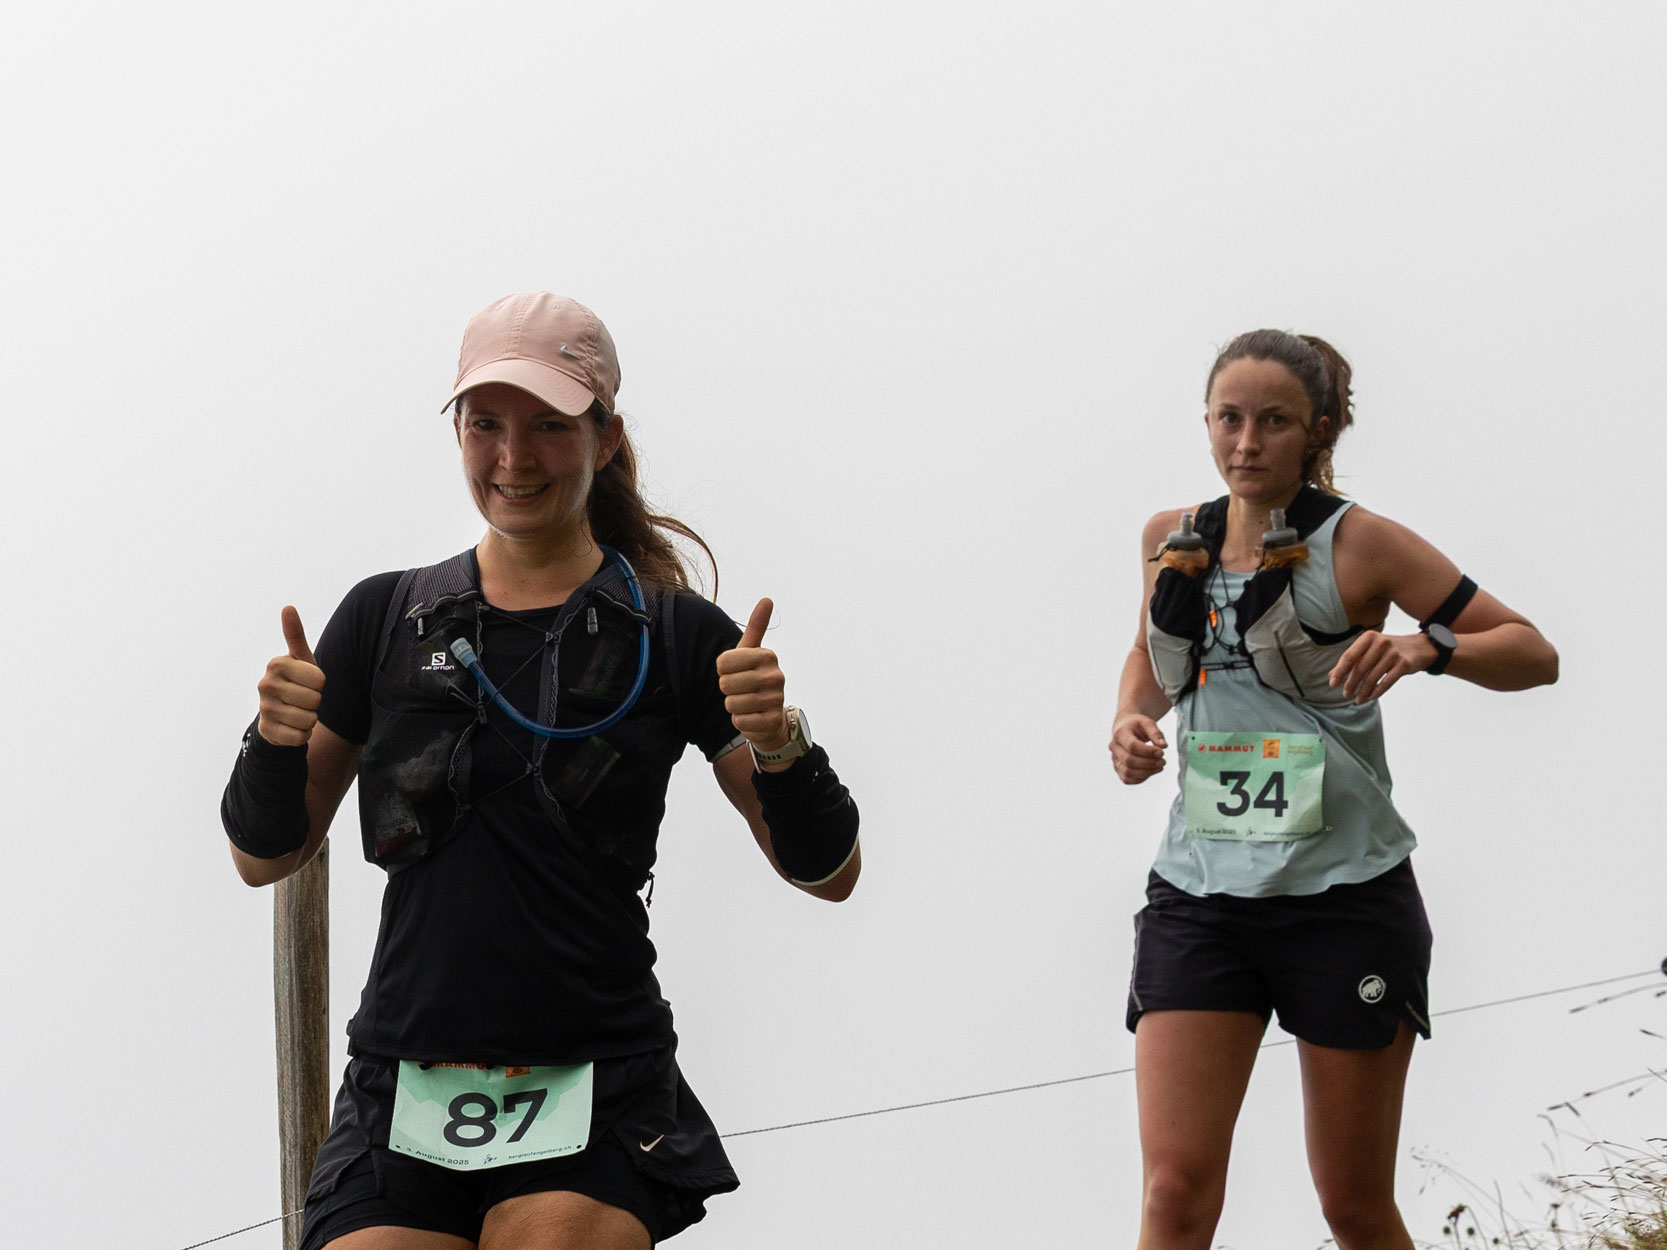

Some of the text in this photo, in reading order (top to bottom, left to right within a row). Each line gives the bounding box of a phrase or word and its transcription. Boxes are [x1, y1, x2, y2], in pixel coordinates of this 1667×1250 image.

[1216, 771, 1288, 817] 34
[432, 1062, 486, 1070] MAMMU
[443, 1088, 548, 1148] 87
[415, 1150, 445, 1162] August
